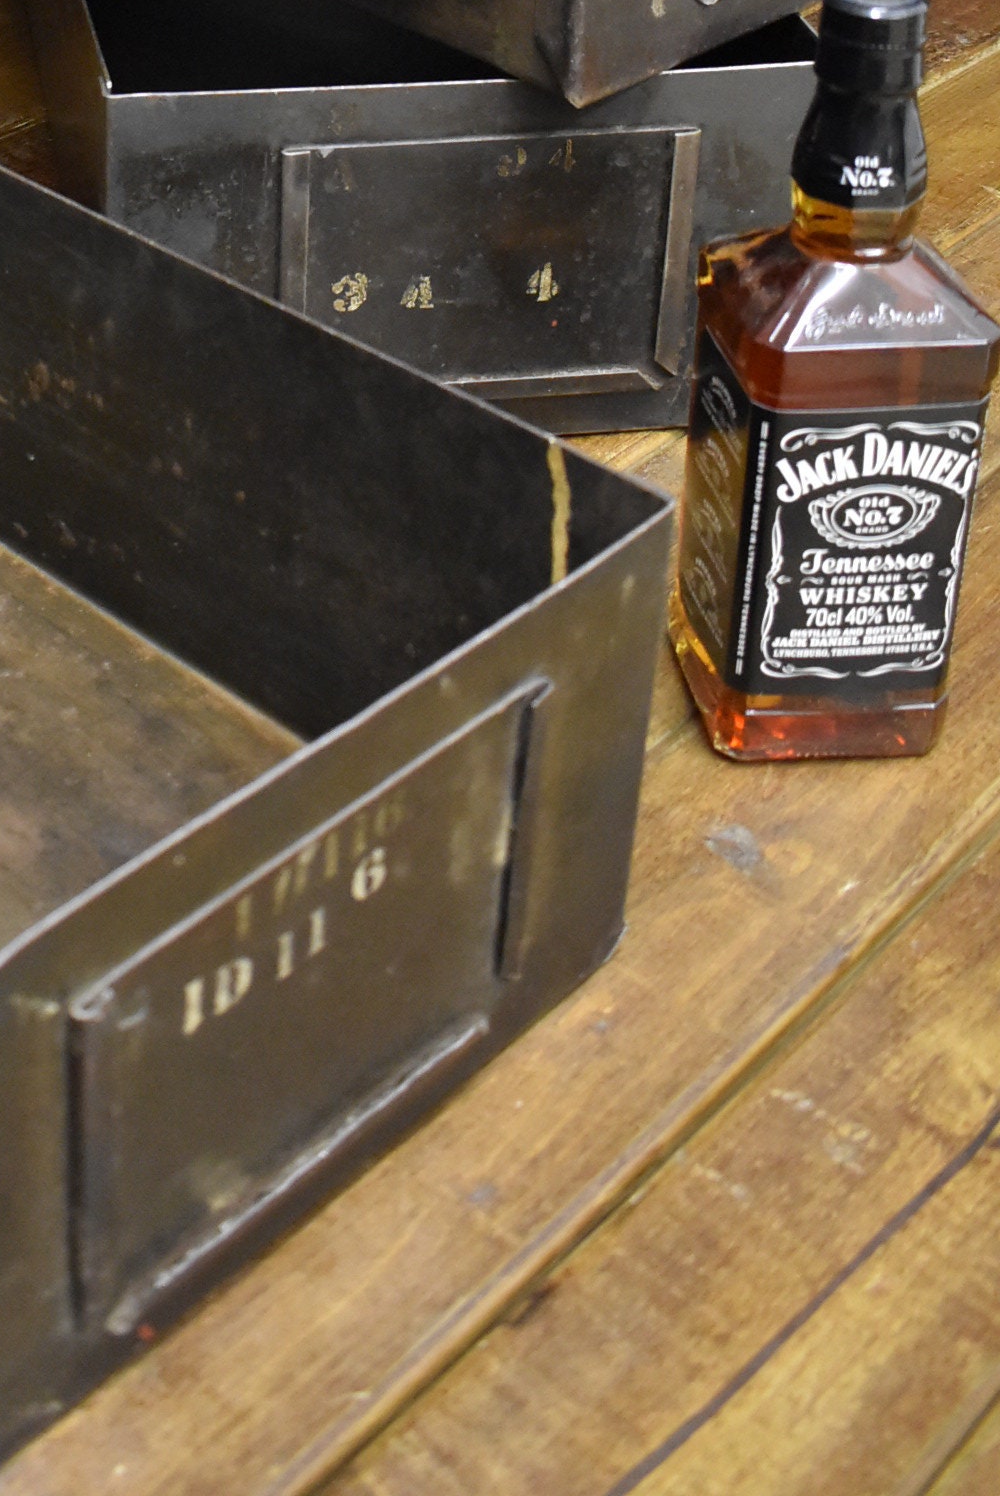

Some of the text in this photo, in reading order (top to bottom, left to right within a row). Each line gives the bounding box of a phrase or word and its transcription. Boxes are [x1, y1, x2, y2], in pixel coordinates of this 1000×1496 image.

[854, 155, 880, 169] Old
[775, 431, 979, 503] JACK DANIEL'S
[859, 496, 890, 508] Old
[799, 548, 935, 574] Tennessee
[799, 582, 929, 605] WHISKEY
[806, 603, 916, 627] 70cl 40% Vol.
[771, 636, 809, 647] JACK
